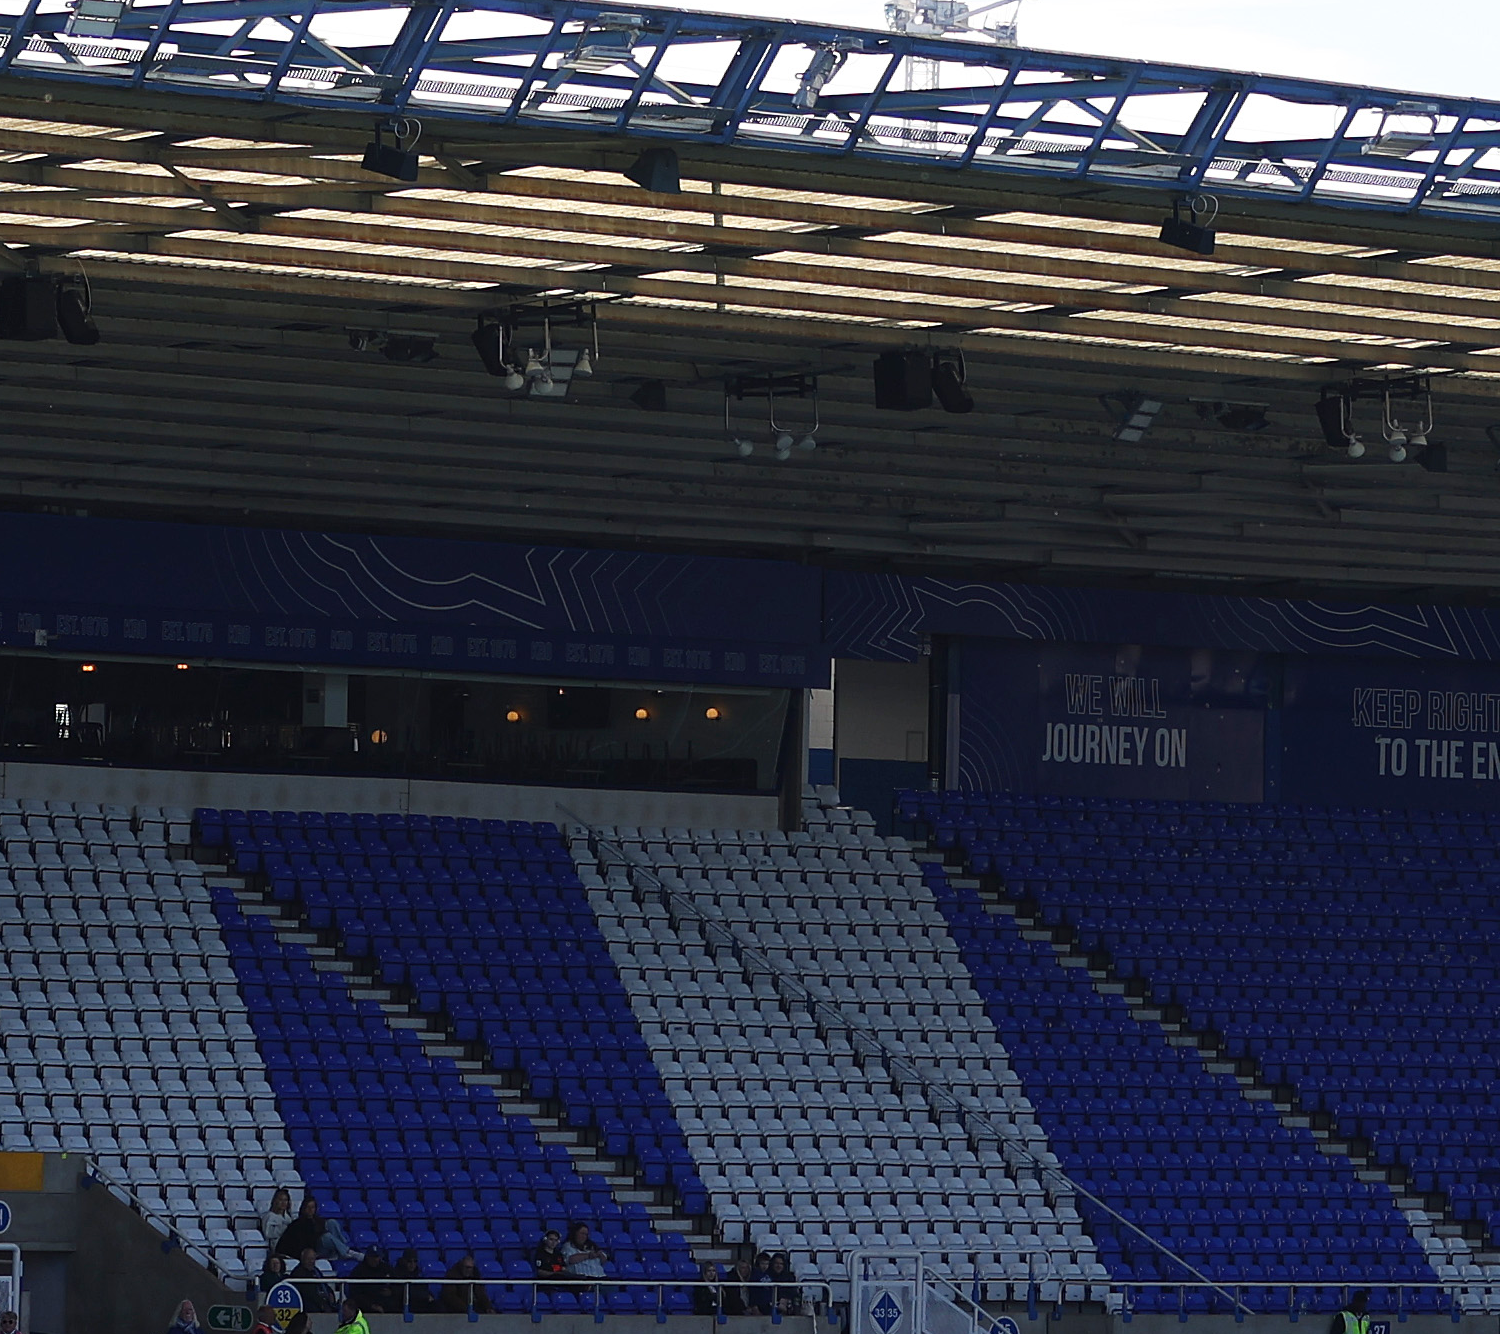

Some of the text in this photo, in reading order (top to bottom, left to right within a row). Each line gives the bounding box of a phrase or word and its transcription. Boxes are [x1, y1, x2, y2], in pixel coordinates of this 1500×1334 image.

[1109, 676, 1166, 719] WILL
[1354, 688, 1421, 728] KEEP
[1042, 722, 1187, 768] JOURNEY ON
[1378, 736, 1408, 776] TO
[1416, 739, 1464, 778] THE
[277, 1290, 291, 1304] 33
[277, 1308, 291, 1321] 32
[875, 1308, 898, 1317] 33 35
